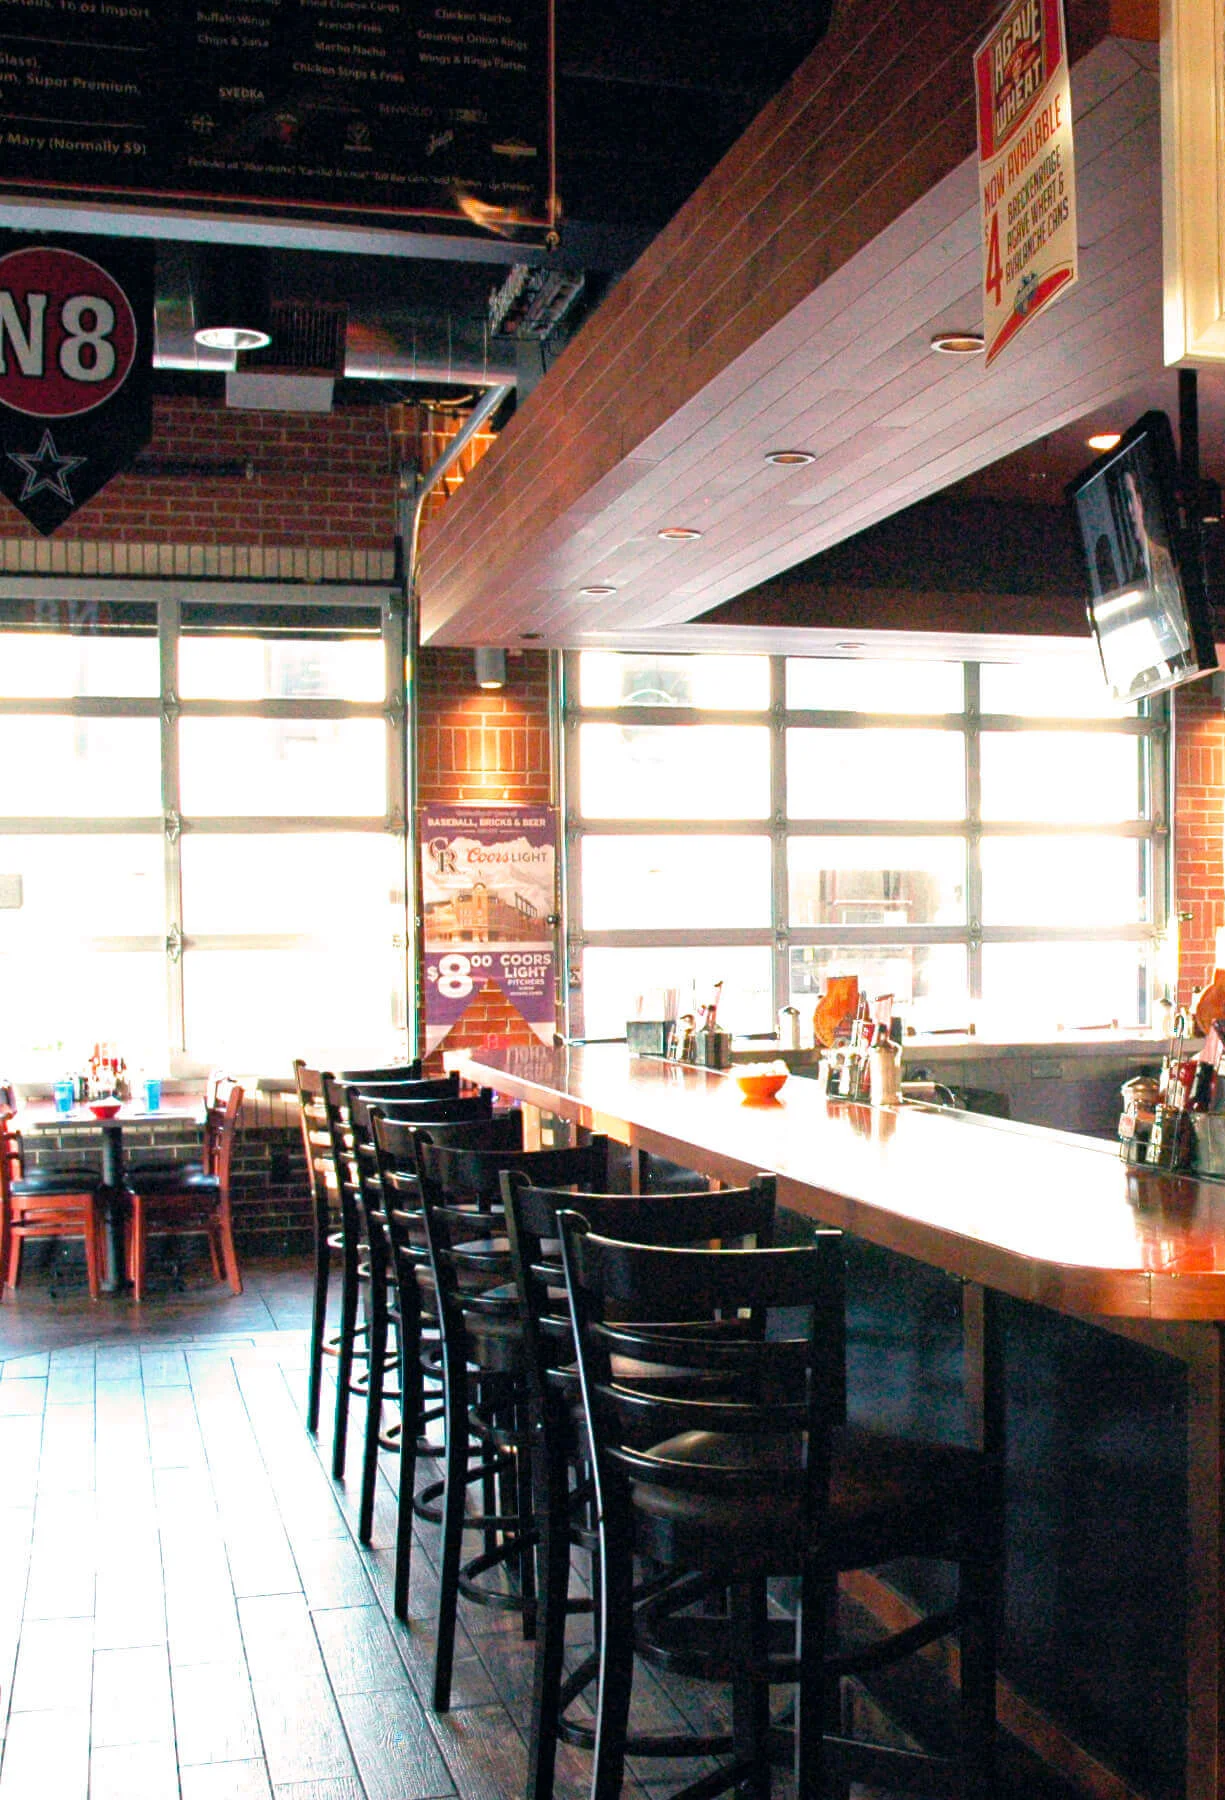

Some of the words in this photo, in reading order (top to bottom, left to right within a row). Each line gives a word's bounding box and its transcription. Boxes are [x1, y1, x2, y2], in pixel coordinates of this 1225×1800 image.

[994, 0, 1041, 94] AGAVE
[995, 56, 1041, 137] WHEAT
[984, 163, 1006, 217] NOW
[1007, 94, 1062, 186] AVAILABLE
[427, 818, 478, 828] BASEBALL,
[479, 818, 513, 827] BRICKS
[514, 818, 521, 826] &
[522, 818, 546, 827] BEER
[466, 847, 509, 863] Coors
[511, 851, 549, 863] LIGHT
[500, 953, 552, 966] COORS
[504, 966, 548, 979] LIGHT
